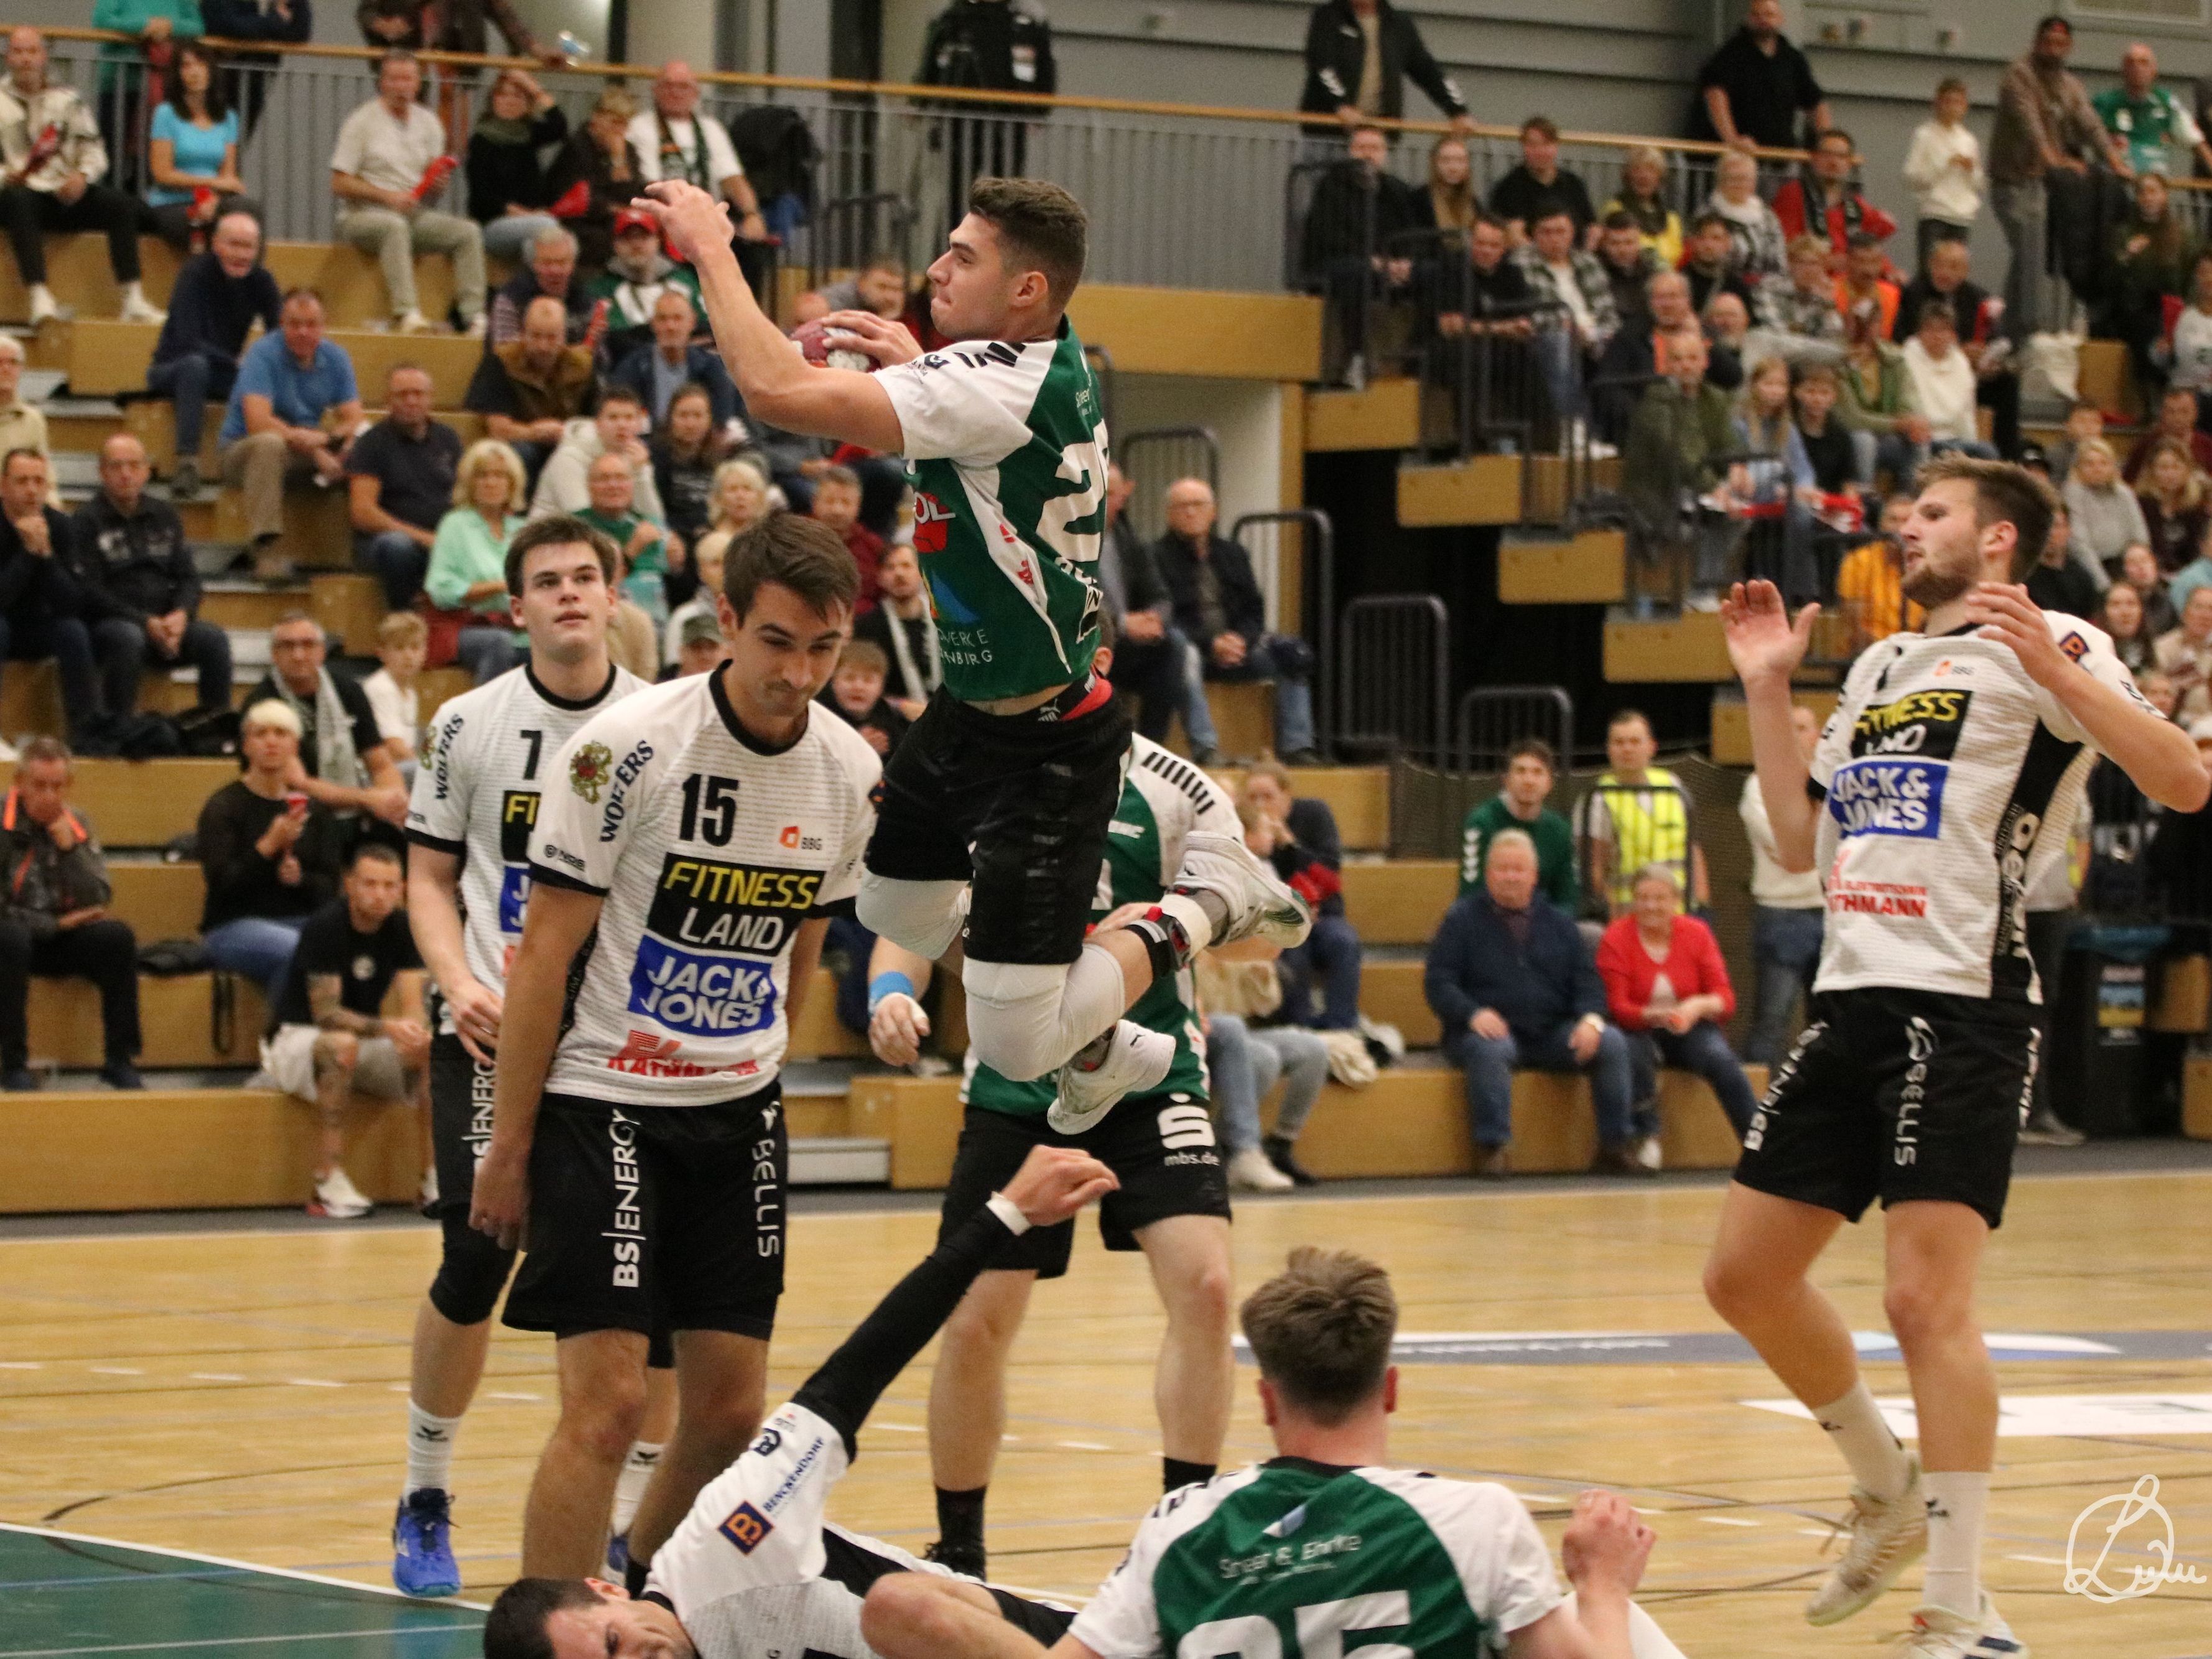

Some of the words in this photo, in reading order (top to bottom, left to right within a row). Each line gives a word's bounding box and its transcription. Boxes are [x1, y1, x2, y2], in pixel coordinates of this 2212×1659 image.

[519, 730, 542, 780] 7
[679, 773, 740, 847] 15
[663, 861, 820, 911] FITNESS
[679, 906, 784, 950] LAND
[639, 987, 766, 1029] JONES
